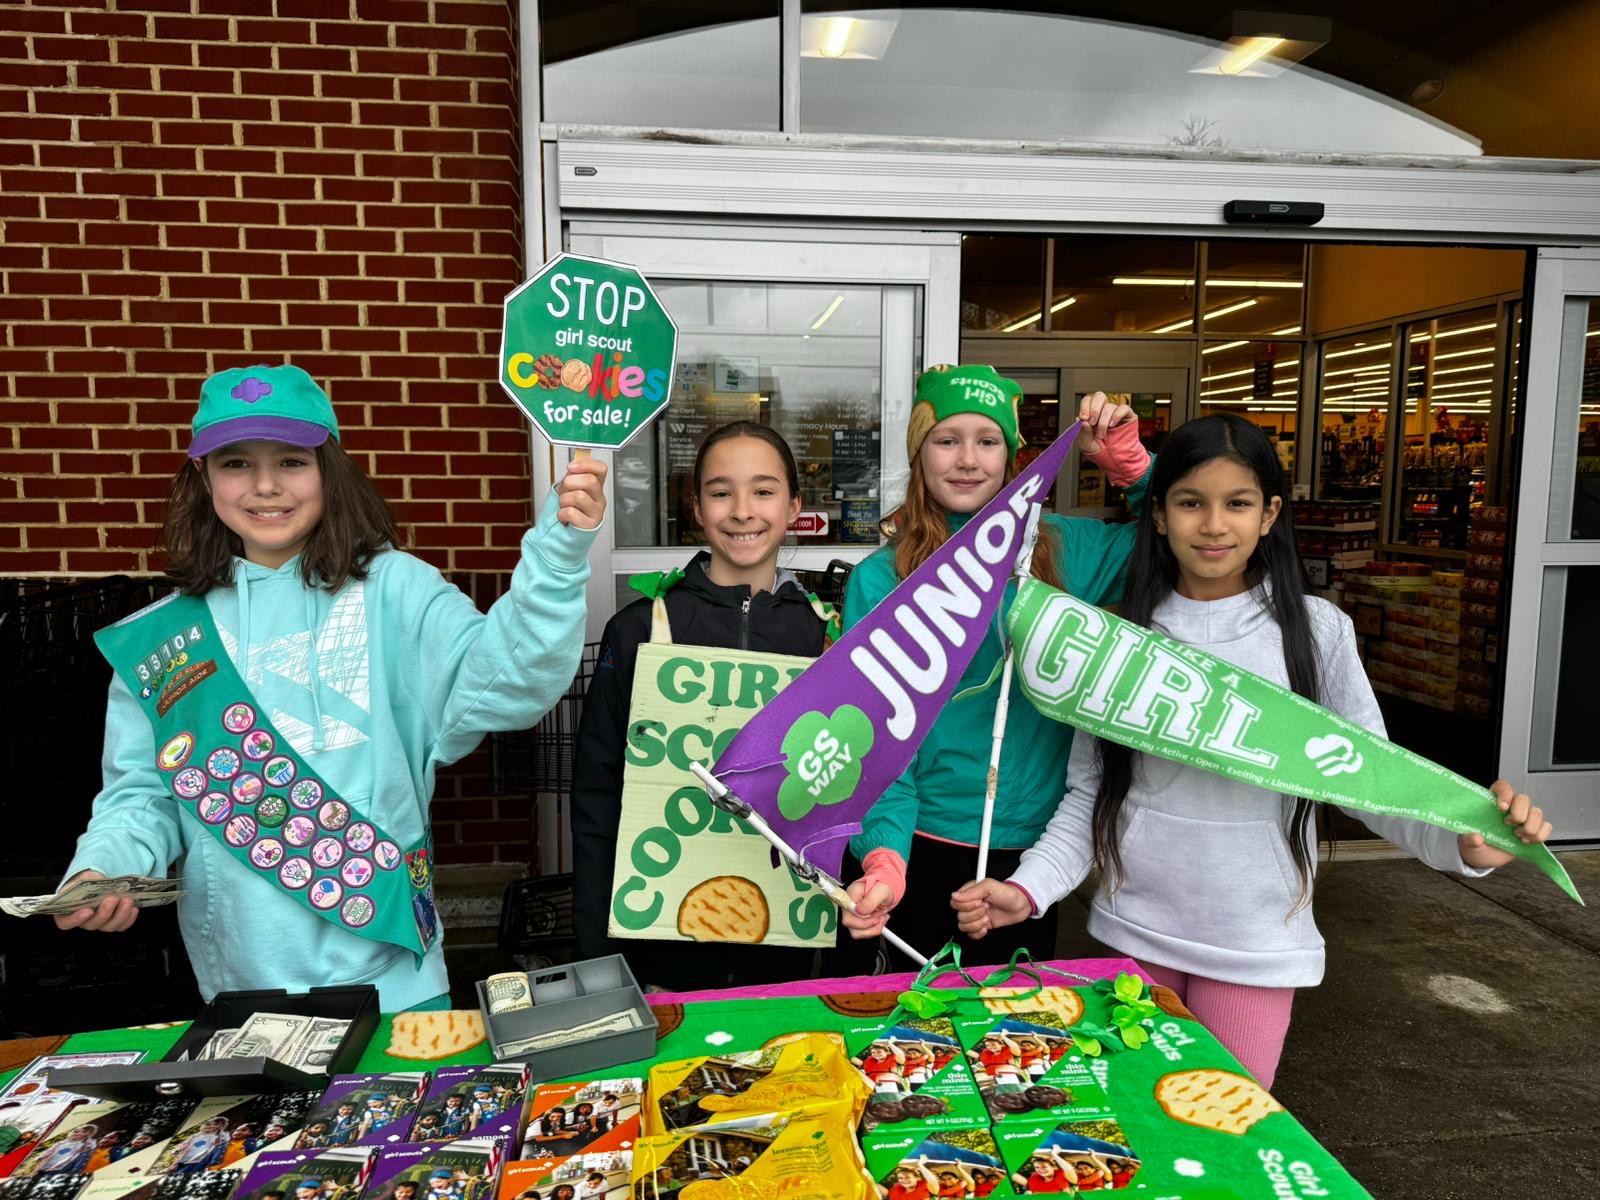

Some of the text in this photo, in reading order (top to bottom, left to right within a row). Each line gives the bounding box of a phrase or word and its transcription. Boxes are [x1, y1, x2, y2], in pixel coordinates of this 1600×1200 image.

[547, 273, 646, 328] STOP
[555, 328, 632, 352] girl scout
[508, 352, 666, 402] cookies
[949, 377, 1006, 403] Scouts
[964, 387, 997, 407] Girl
[543, 400, 631, 428] for sale!
[850, 473, 1043, 741] JUNIOR
[138, 626, 201, 680] 33104
[1160, 638, 1217, 673] LIKE
[1221, 673, 1242, 689] A
[657, 657, 805, 708] GIR
[1020, 593, 1279, 770] GIRL
[797, 728, 840, 782] GS
[1289, 694, 1322, 714] Explore
[1327, 714, 1364, 736] Magical
[1367, 735, 1398, 754] Happy
[1404, 752, 1445, 776] Inspired
[806, 742, 854, 797] WAY
[1066, 714, 1094, 730] Simple
[1099, 727, 1134, 744] Amazed
[1140, 740, 1155, 753] Joy
[1162, 746, 1189, 761] Active
[1195, 757, 1220, 771] Open
[1226, 766, 1265, 784] Exciting
[1271, 779, 1314, 796] Limitless
[1322, 790, 1357, 804] Unique
[1363, 800, 1420, 816] Experience
[1427, 811, 1447, 824] Fun
[1160, 1022, 1196, 1046] Girl
[384, 1151, 398, 1160] girl
[508, 1168, 522, 1176] girl
[1288, 1160, 1329, 1197] Girl
